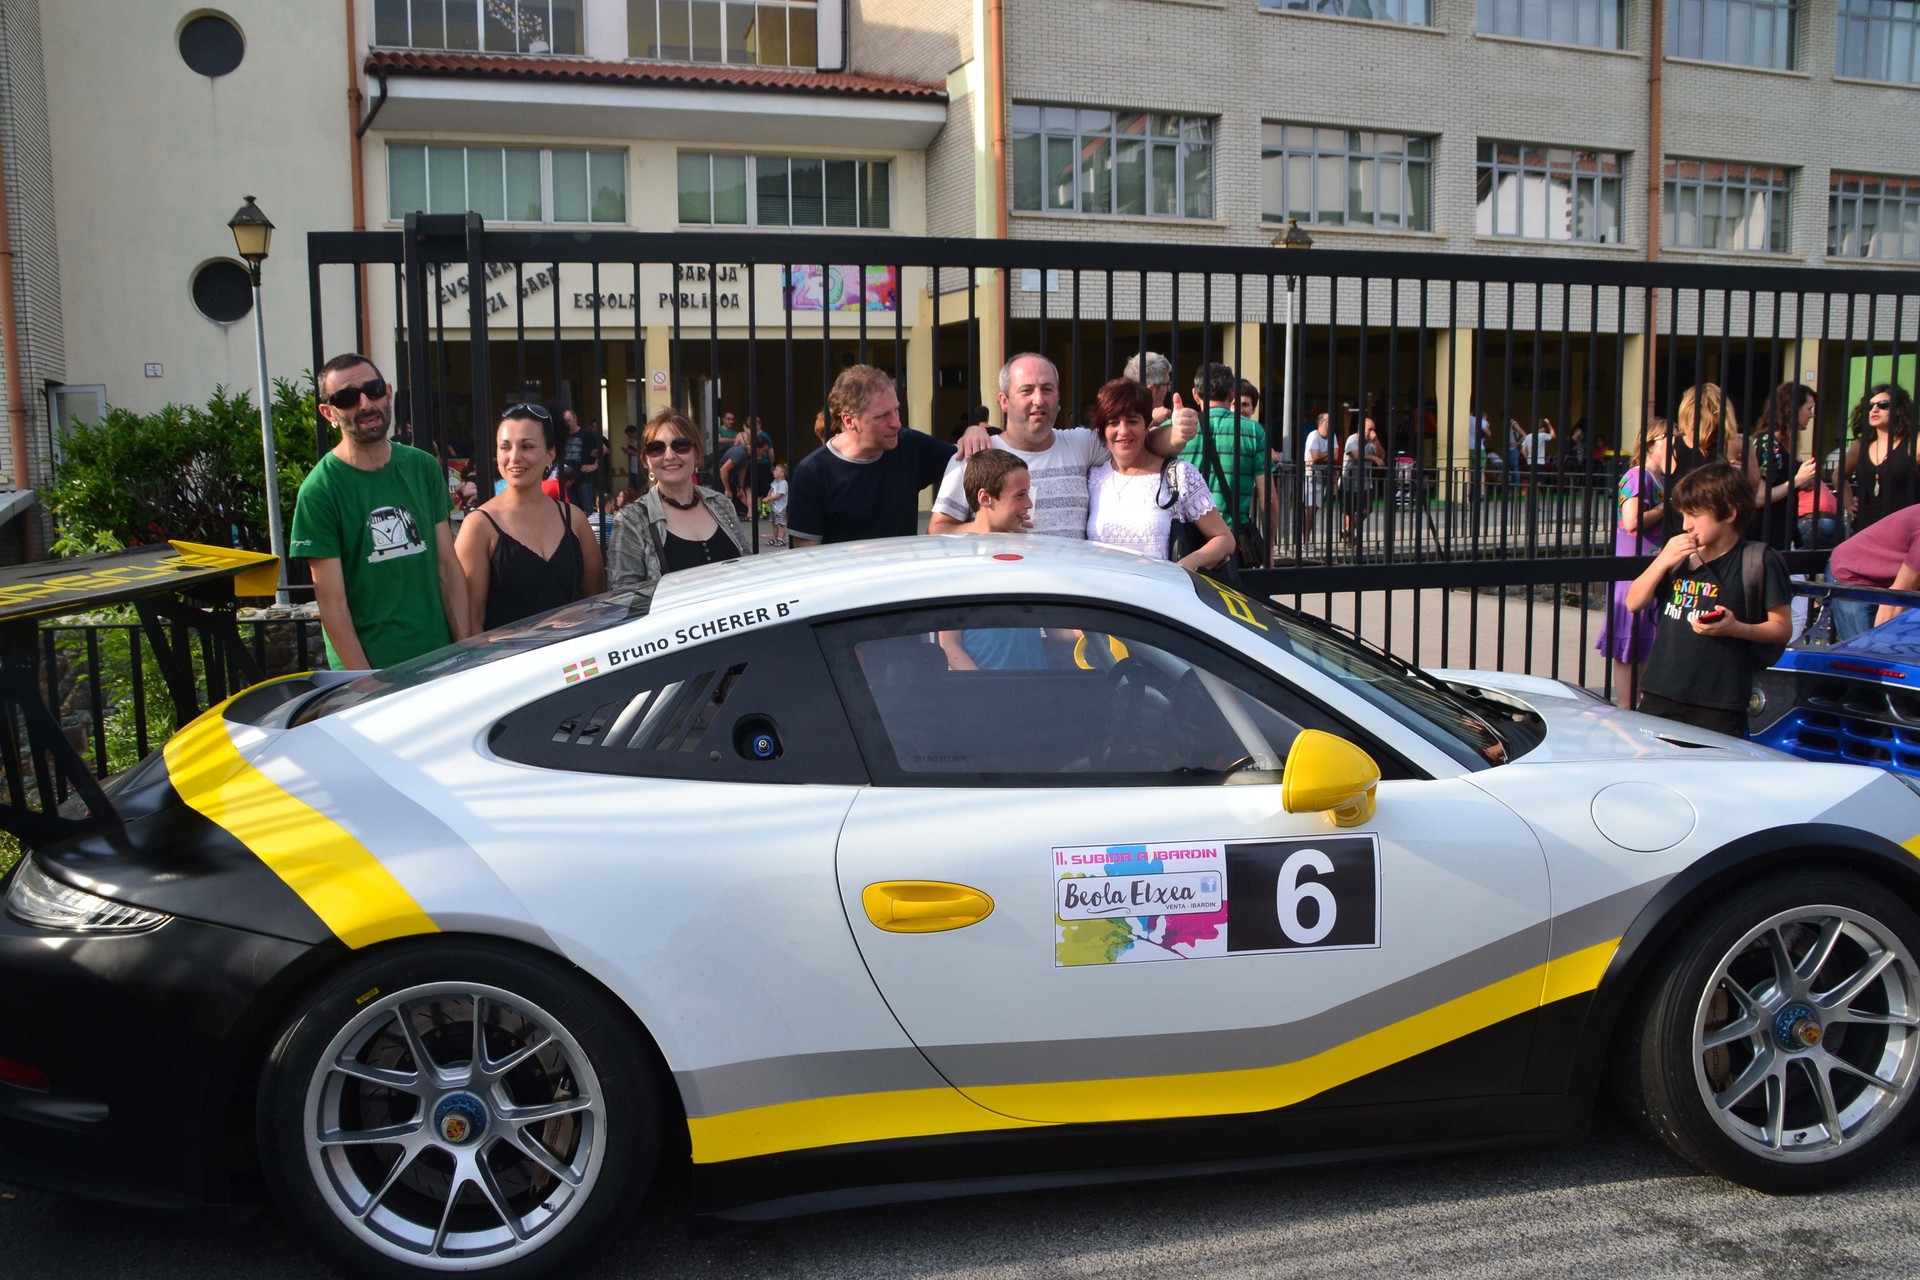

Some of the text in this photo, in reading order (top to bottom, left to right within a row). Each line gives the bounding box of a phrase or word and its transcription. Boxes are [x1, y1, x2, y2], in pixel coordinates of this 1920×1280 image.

[1674, 591, 1699, 609] bizi
[608, 637, 669, 666] Bruno
[675, 607, 771, 645] SCHERER
[1071, 851, 1133, 865] SUBIDA
[1138, 851, 1148, 862] A
[1153, 848, 1217, 861] IBARDIN
[1064, 881, 1127, 909] Beola
[1276, 848, 1337, 944] 6
